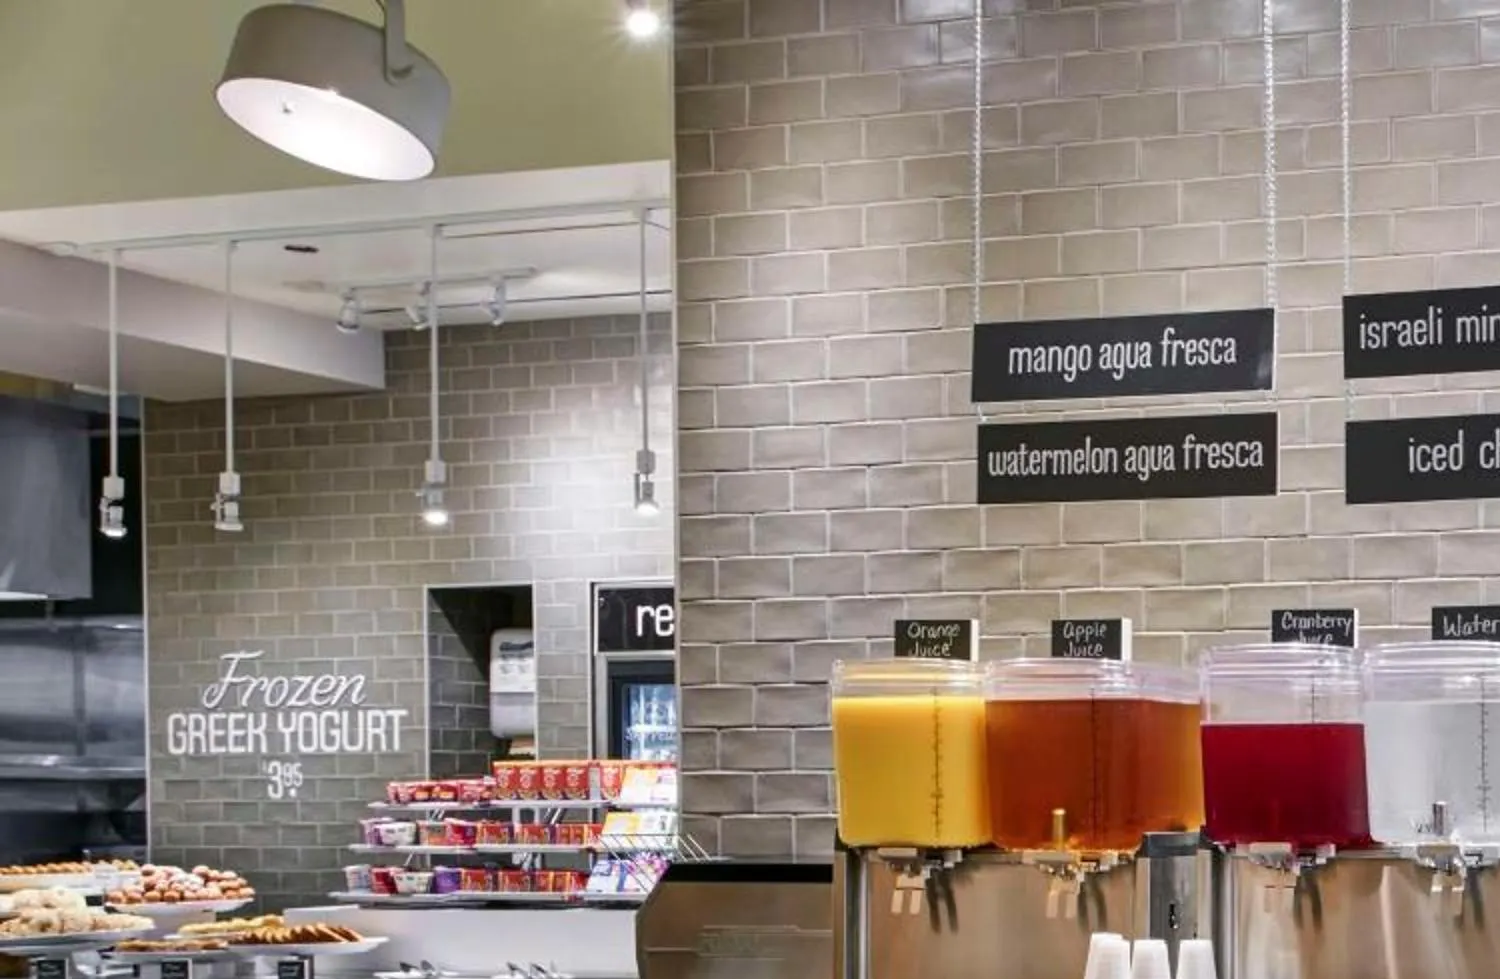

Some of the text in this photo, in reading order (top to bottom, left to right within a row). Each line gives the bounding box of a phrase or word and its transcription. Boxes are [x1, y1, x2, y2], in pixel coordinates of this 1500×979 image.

[1359, 305, 1443, 350] israeli
[1008, 326, 1237, 382] mango agua fresca
[988, 433, 1264, 481] watermelon agua fresca
[1408, 428, 1465, 473] iced
[636, 603, 675, 637] re
[907, 621, 961, 646] Orange
[1281, 611, 1352, 637] Cranberry
[1443, 613, 1500, 637] Water
[907, 640, 952, 658] Juice
[1063, 641, 1104, 658] Juice
[203, 650, 367, 708] Frozen
[167, 709, 408, 754] GREEK YOGURT
